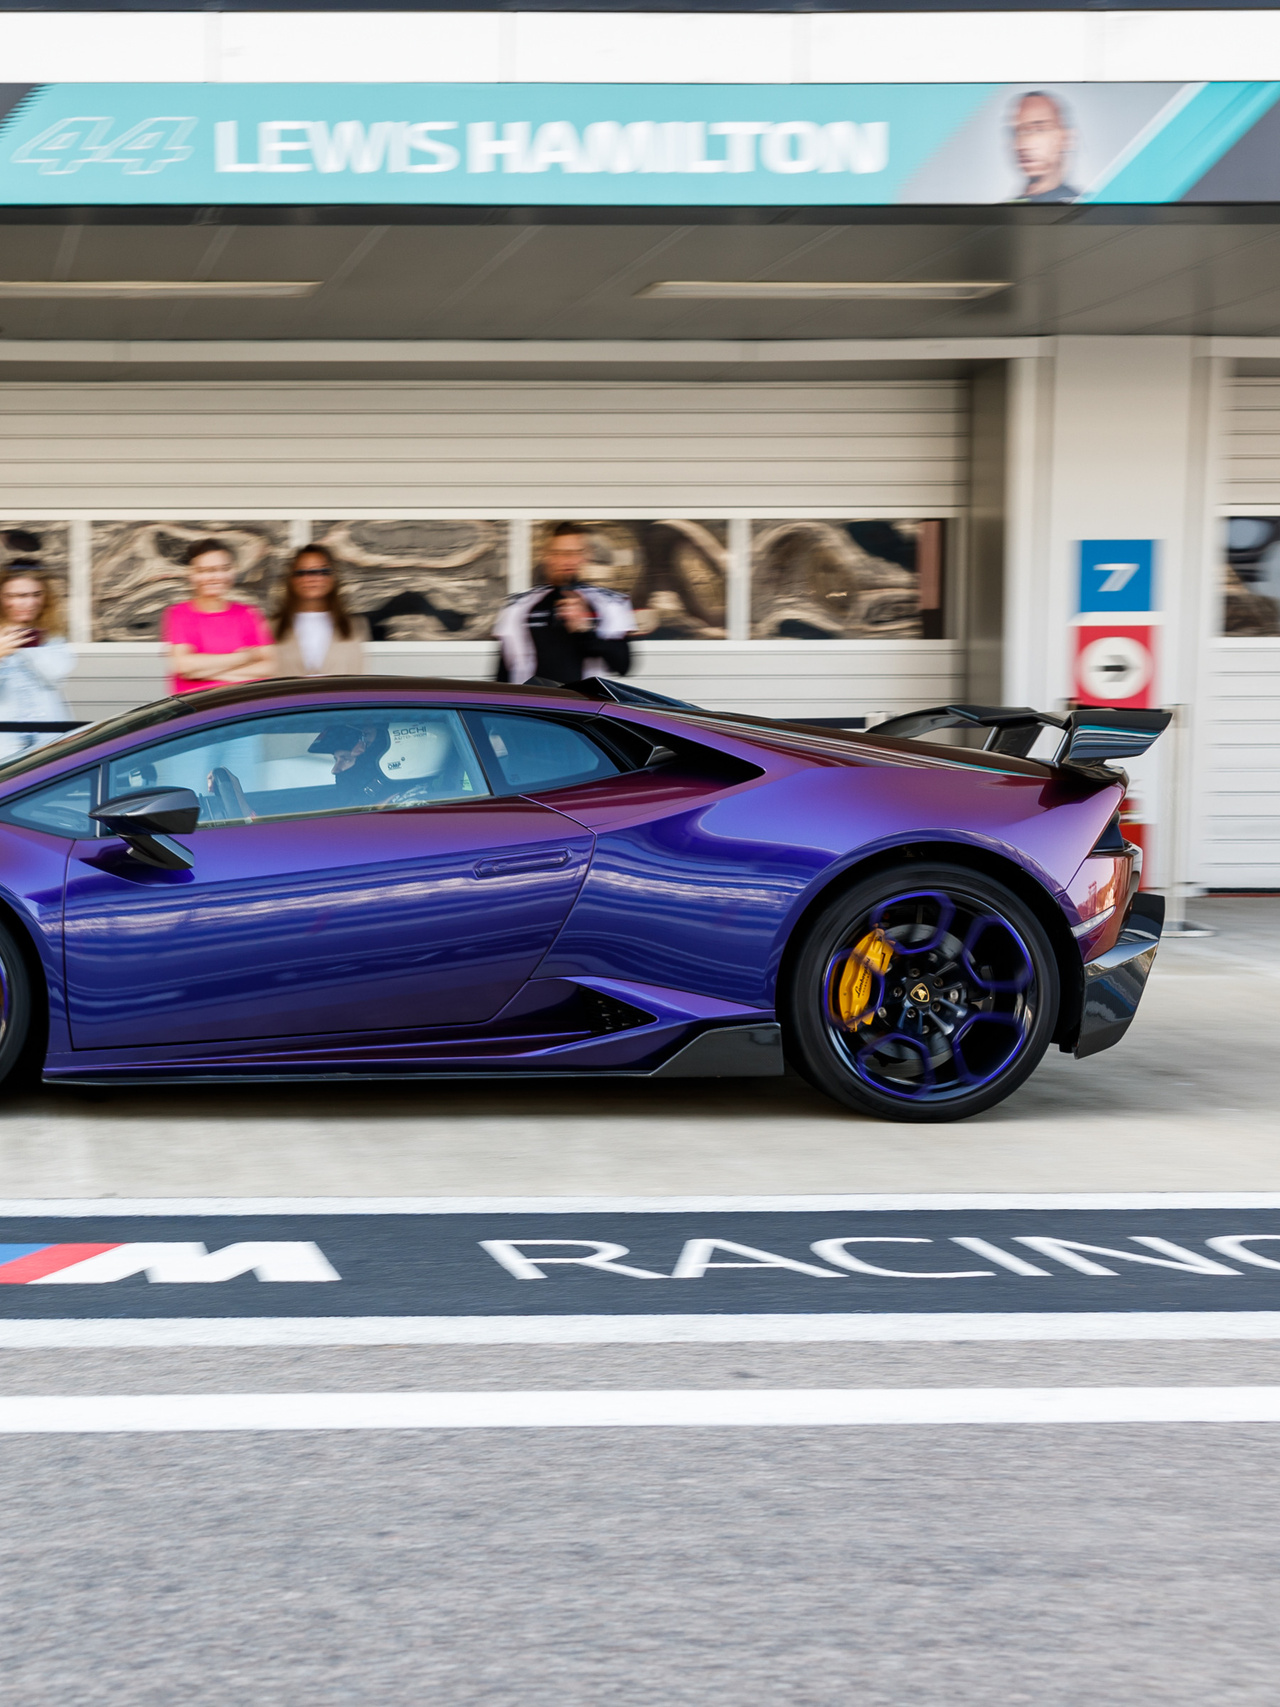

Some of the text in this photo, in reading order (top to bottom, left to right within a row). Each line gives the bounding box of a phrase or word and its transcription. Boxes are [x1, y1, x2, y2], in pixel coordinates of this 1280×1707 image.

[10, 115, 891, 175] 44 LEWIS HAMILTON
[1093, 563, 1141, 592] 7
[392, 725, 427, 736] SOCHI
